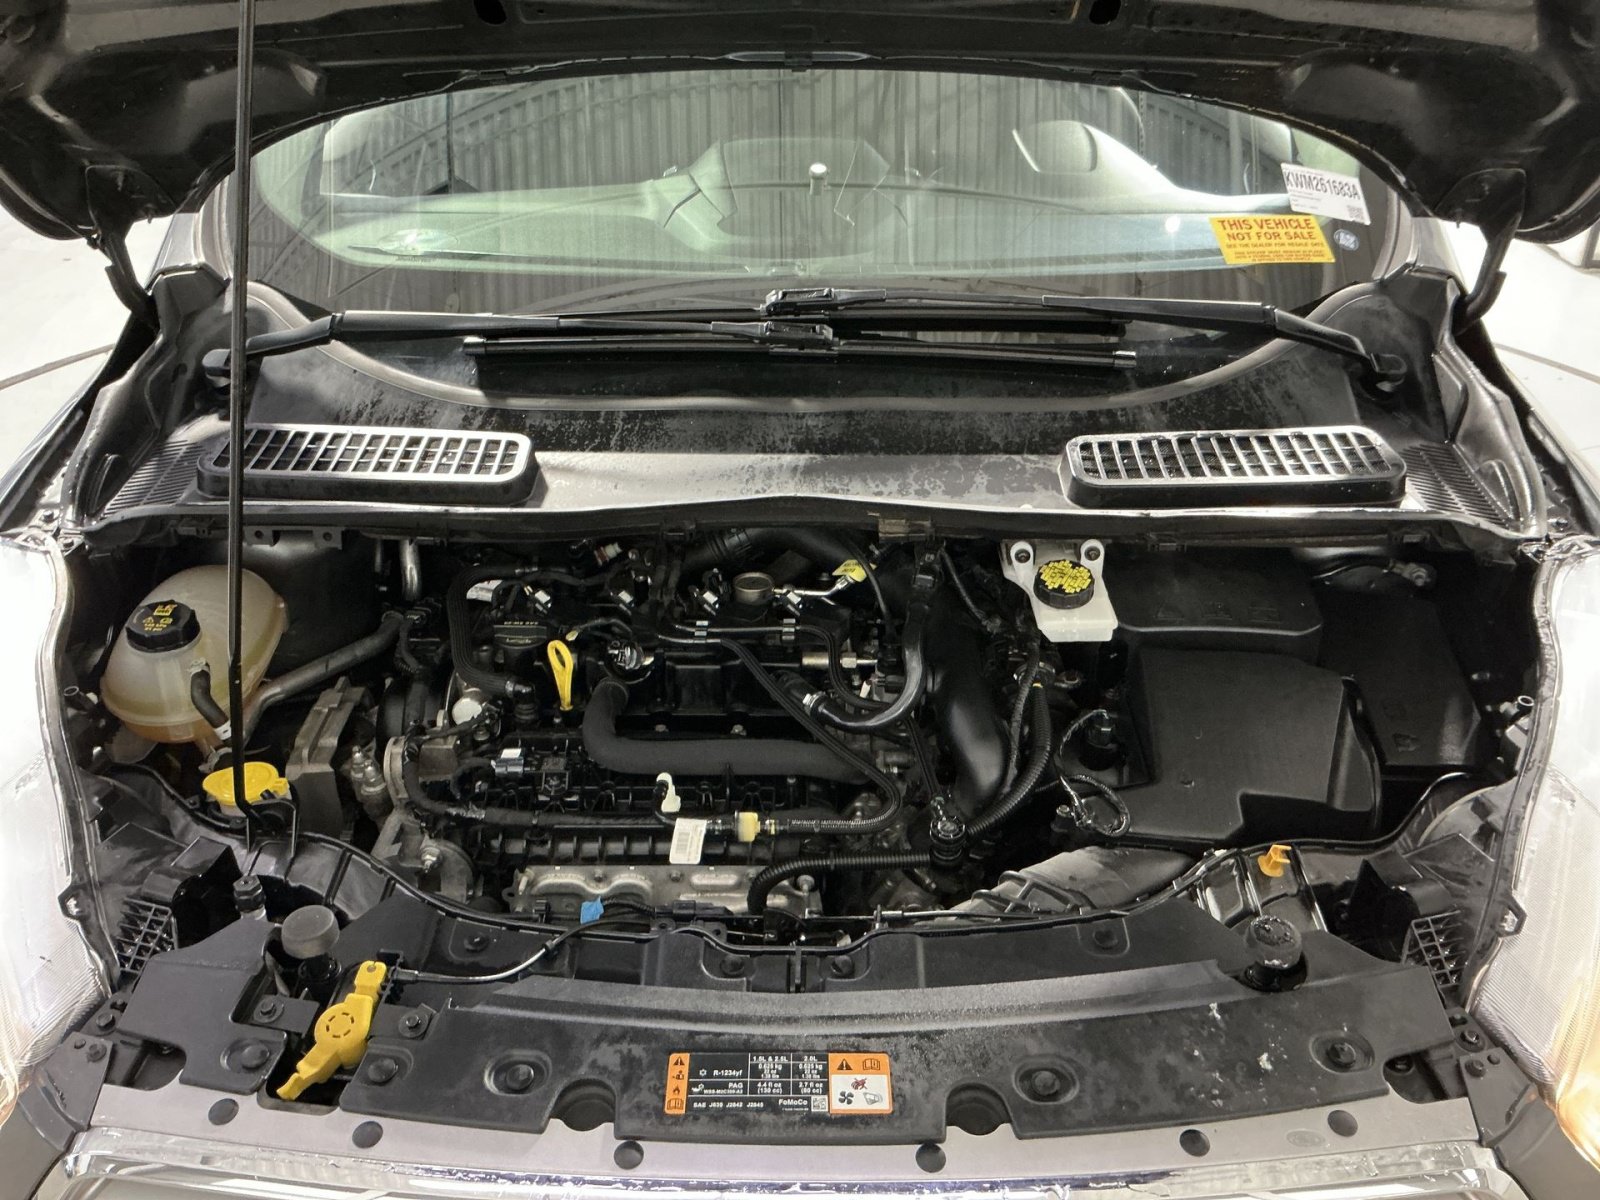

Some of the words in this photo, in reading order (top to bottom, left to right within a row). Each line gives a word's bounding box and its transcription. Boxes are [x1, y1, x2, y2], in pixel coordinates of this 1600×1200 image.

[1284, 170, 1361, 200] KWM261683A
[1217, 219, 1253, 230] THIS
[1253, 218, 1315, 230] VEHICLE
[1226, 231, 1252, 241] NOT
[1255, 231, 1281, 241] FOR
[1284, 231, 1317, 240] SALE
[713, 1069, 743, 1077] R-1234yf
[778, 1098, 808, 1106] FoMoCo
